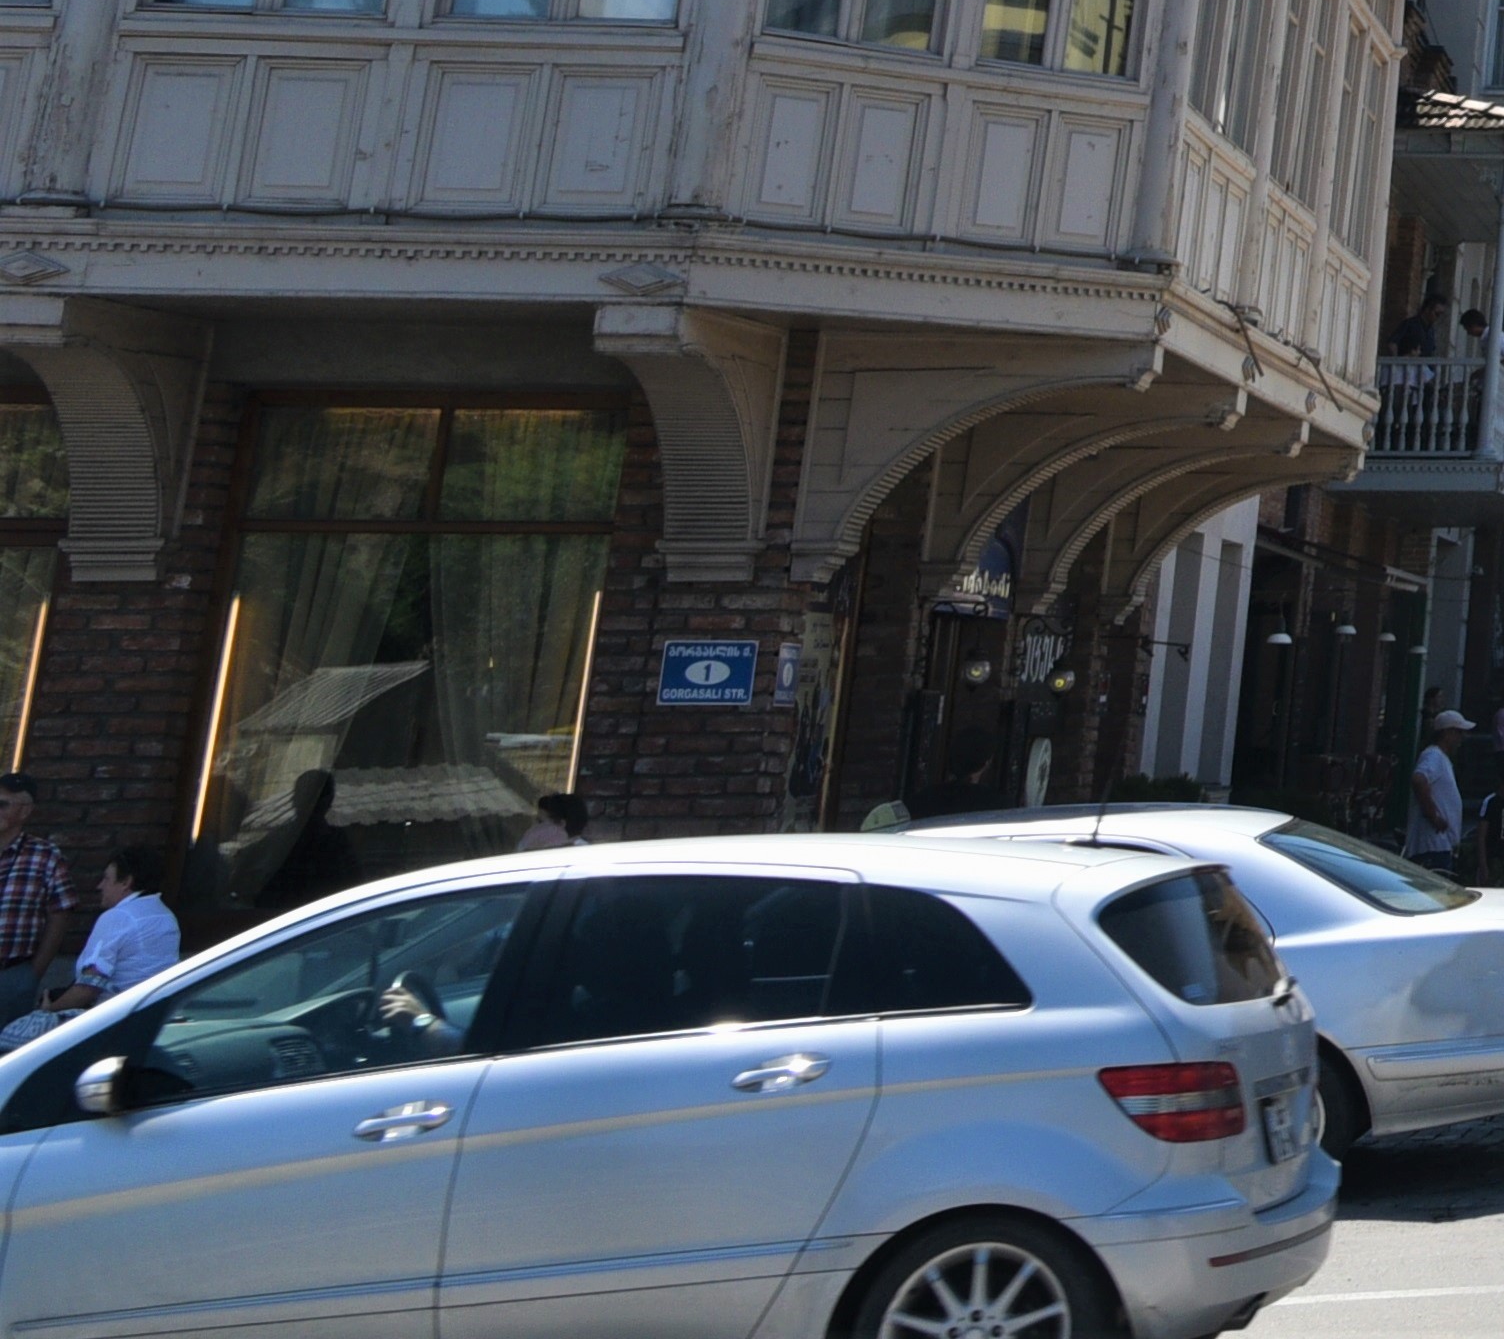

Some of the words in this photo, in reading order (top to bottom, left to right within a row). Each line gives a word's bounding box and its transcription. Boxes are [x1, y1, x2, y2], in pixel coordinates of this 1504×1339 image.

[703, 663, 712, 682] 1
[662, 688, 721, 700] GORGASALI
[724, 688, 748, 700] STR.
